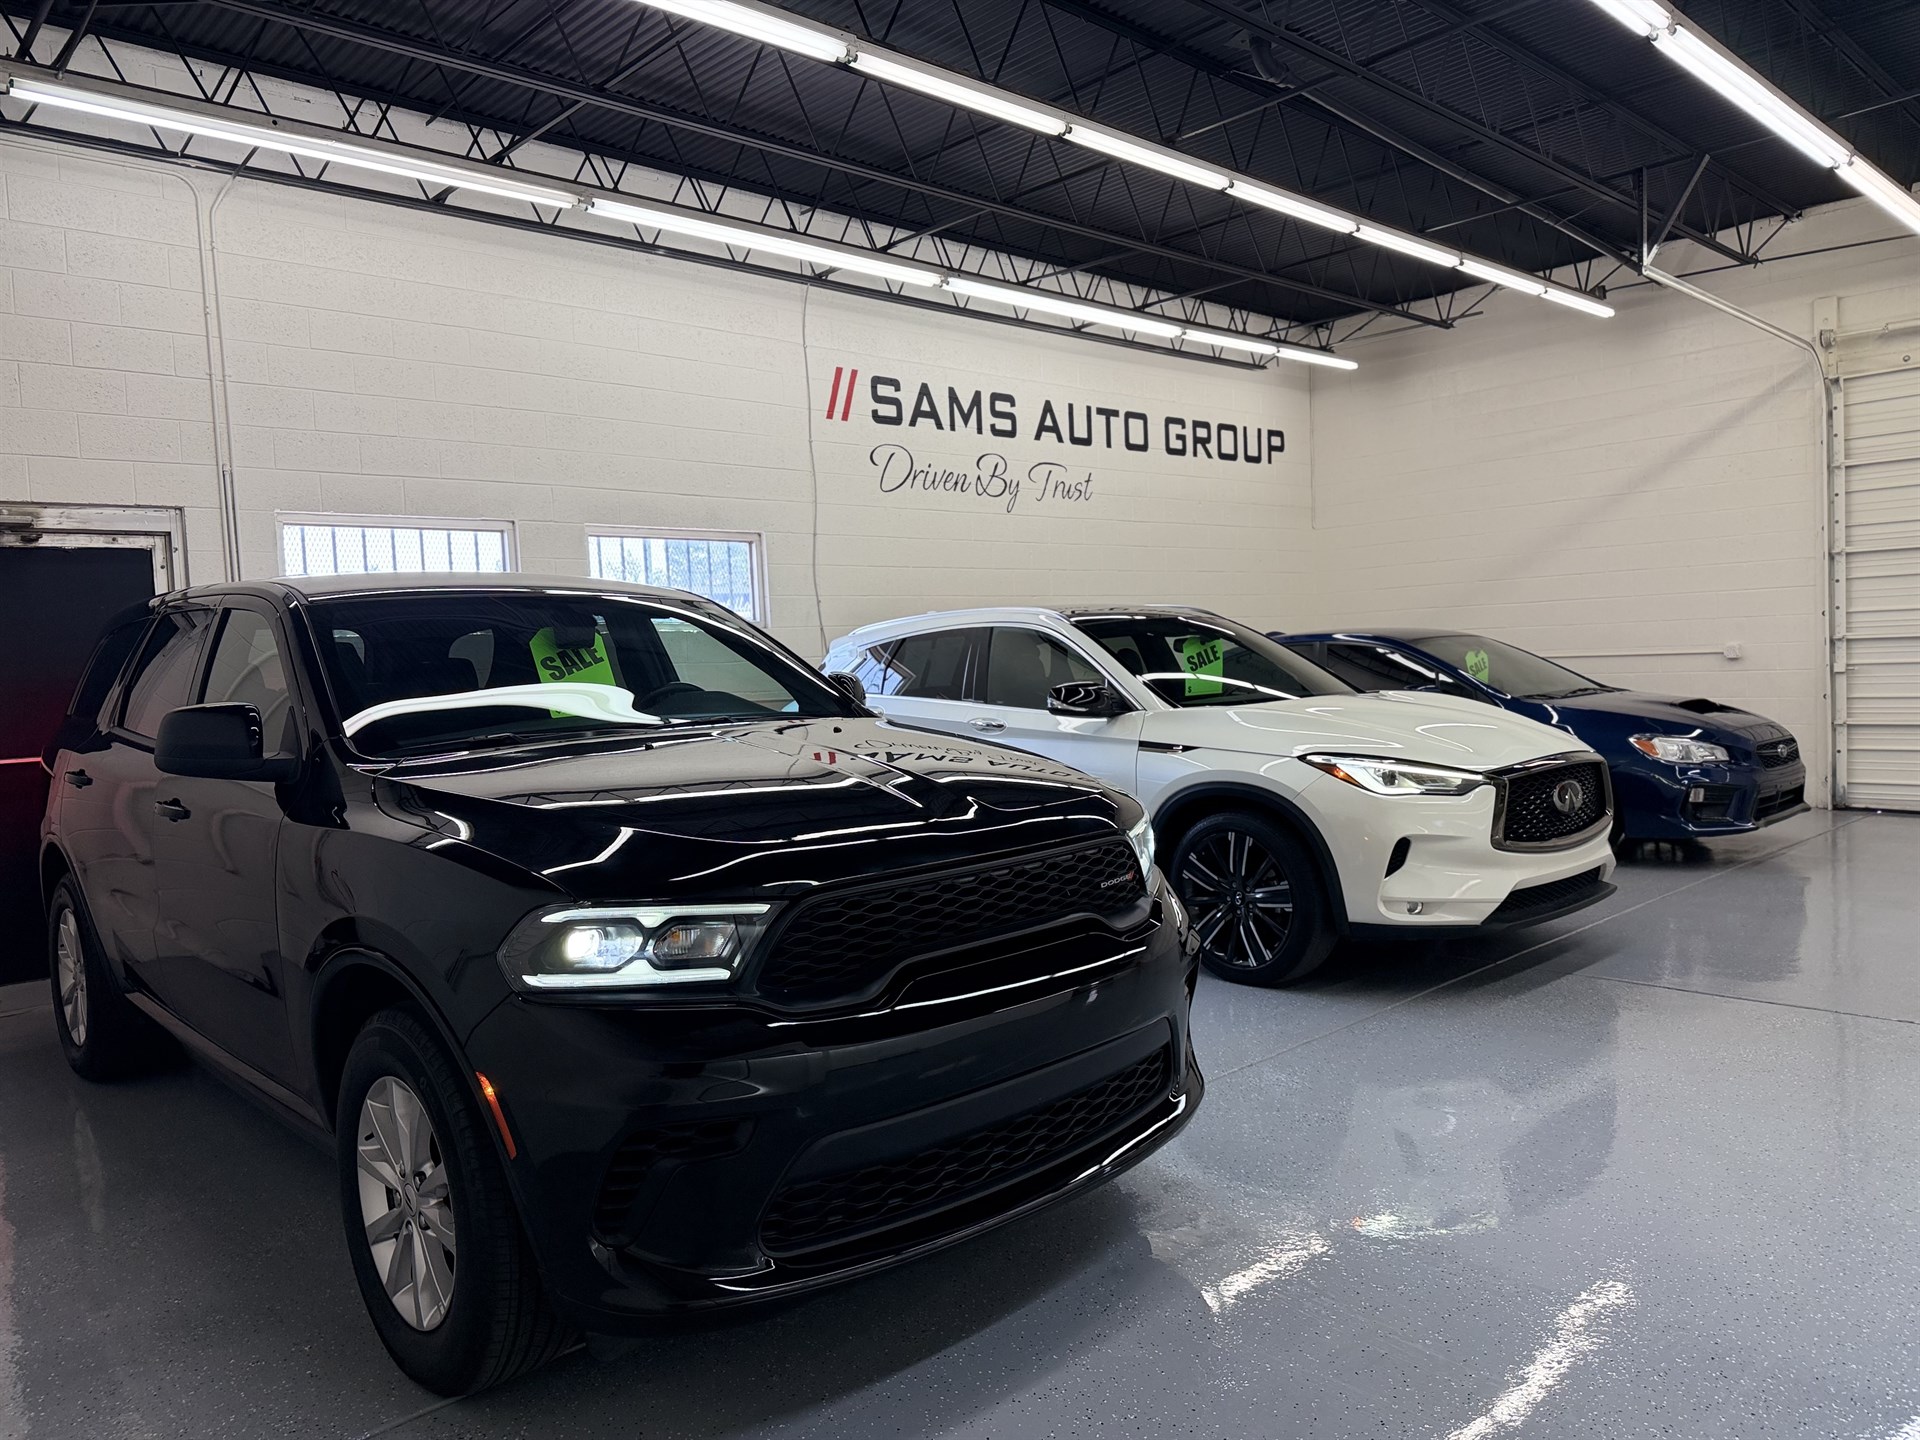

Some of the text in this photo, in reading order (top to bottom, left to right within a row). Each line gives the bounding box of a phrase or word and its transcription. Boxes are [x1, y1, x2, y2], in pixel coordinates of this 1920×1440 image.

[870, 375, 1285, 464] SAMS AUTO GROUP
[869, 443, 1093, 513] Driven By Trust
[540, 647, 605, 681] SALE
[1186, 644, 1221, 672] SALE
